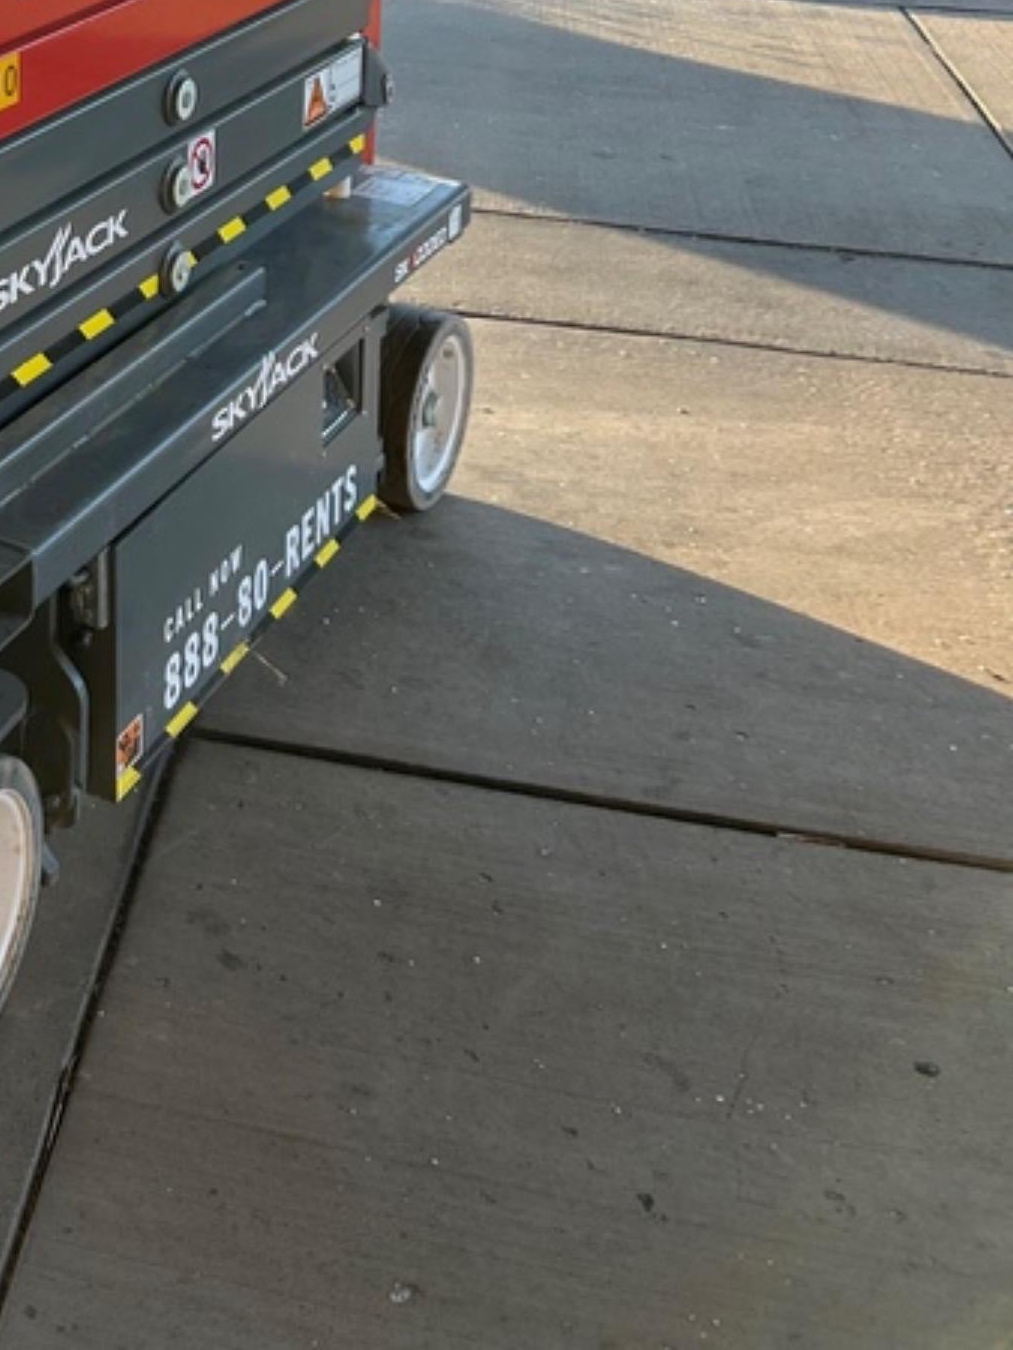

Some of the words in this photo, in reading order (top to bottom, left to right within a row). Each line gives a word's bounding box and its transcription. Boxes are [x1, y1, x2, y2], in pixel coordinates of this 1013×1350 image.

[211, 332, 318, 441] SKYJACK
[163, 464, 358, 709] 888-80-RENTS
[163, 587, 203, 643] CALL
[209, 544, 243, 597] NOW
